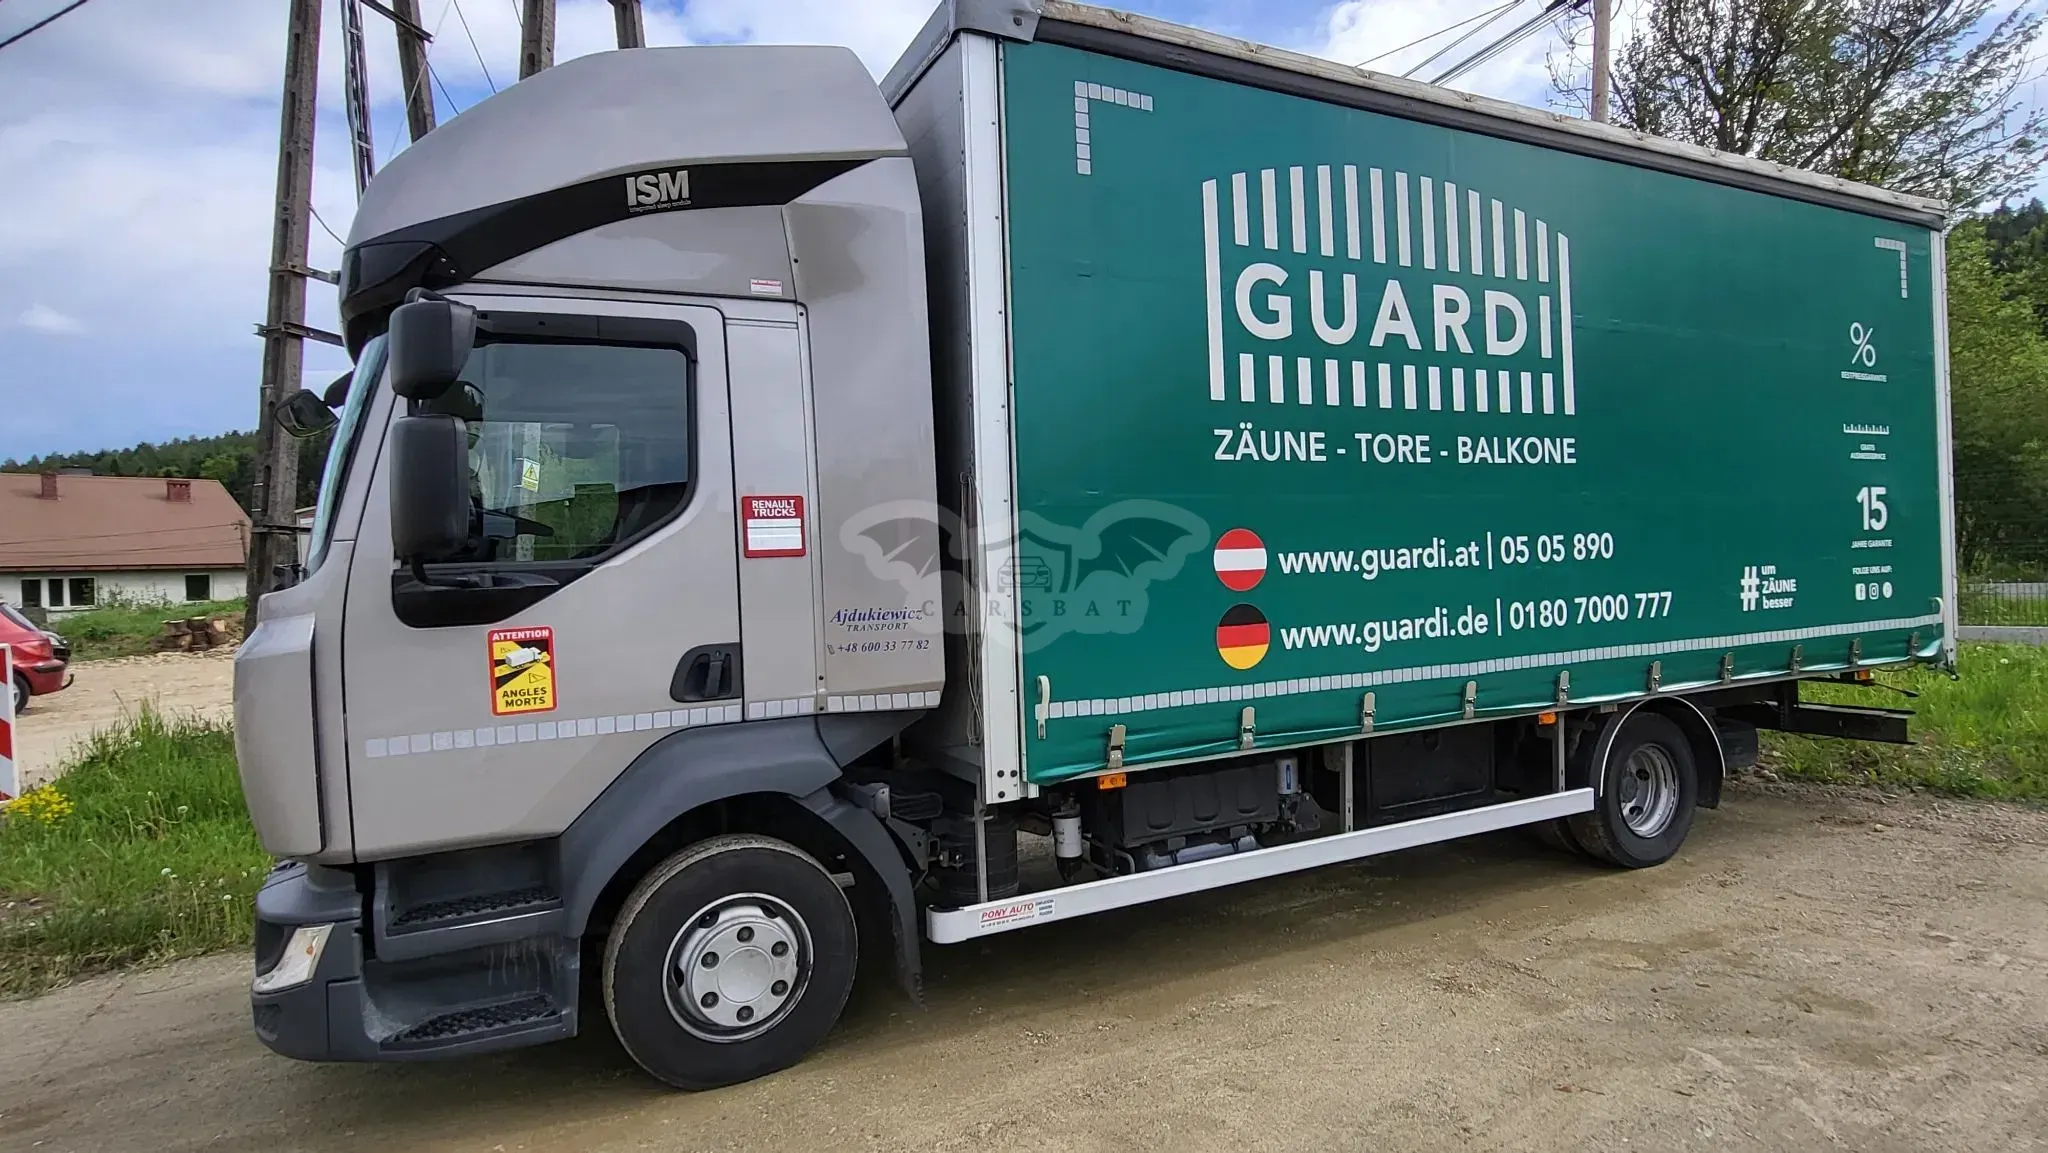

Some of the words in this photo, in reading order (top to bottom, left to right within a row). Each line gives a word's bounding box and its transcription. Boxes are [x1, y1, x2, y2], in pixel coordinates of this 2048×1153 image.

[626, 170, 689, 206] ISM
[1235, 262, 1553, 359] GUARDI
[1214, 422, 1327, 461] ZÄUNE
[1354, 433, 1431, 462] TORE
[1457, 436, 1577, 464] BALKONE
[752, 499, 795, 509] RENAULT
[1856, 487, 1888, 531] 15
[752, 508, 796, 517] TRUCKS
[1278, 537, 1480, 579] www.guardi.at
[1500, 536, 1530, 564] 05
[1537, 534, 1565, 563] 05
[1573, 532, 1614, 560] 890
[1761, 565, 1776, 575] um
[1762, 577, 1797, 594] ZÄUNE
[1762, 595, 1794, 609] besser
[830, 606, 923, 626] Ajdukiewicz
[1280, 605, 1489, 653] www.guardi.de
[1509, 599, 1567, 630] 0180
[1574, 595, 1629, 624] 7000
[1634, 591, 1672, 619] 777
[846, 622, 909, 632] TRANSPORT
[492, 629, 549, 641] ATTENTION
[837, 642, 858, 653] +48
[861, 641, 881, 652] 600
[883, 641, 897, 651] 33
[901, 640, 914, 650] 77
[916, 640, 930, 650] 82
[502, 686, 548, 699] ANGLES
[505, 696, 546, 708] MORTS
[981, 907, 1008, 921] PONY
[1009, 902, 1034, 915] AUTO
